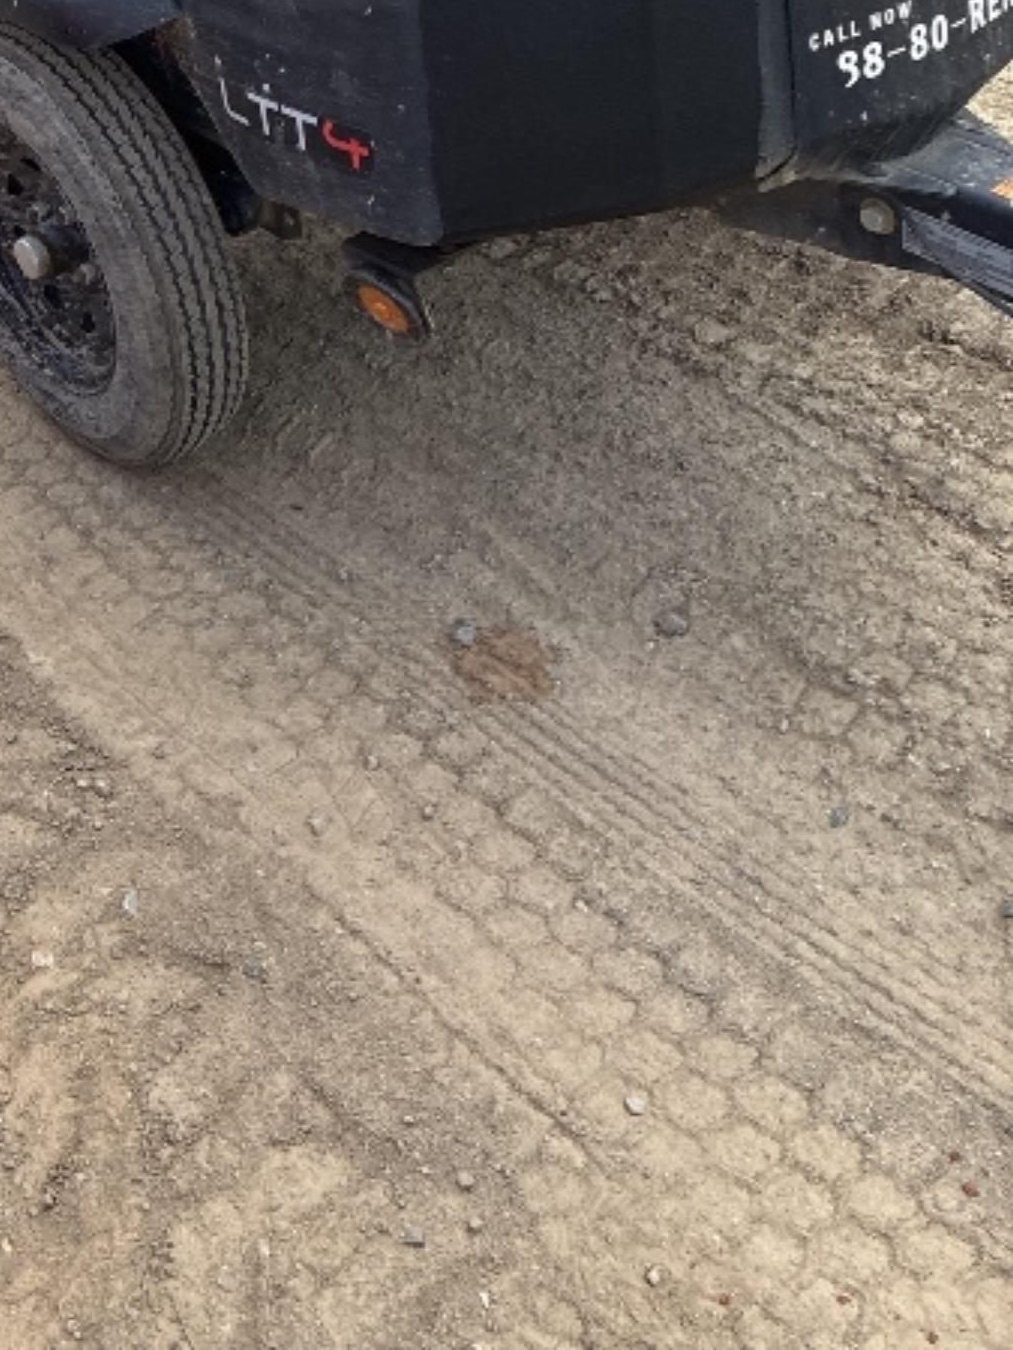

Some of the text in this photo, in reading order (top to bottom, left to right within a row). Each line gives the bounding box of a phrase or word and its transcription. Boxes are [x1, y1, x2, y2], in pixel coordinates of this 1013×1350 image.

[807, 0, 914, 52] CALL NOW
[216, 75, 370, 170] LTT4
